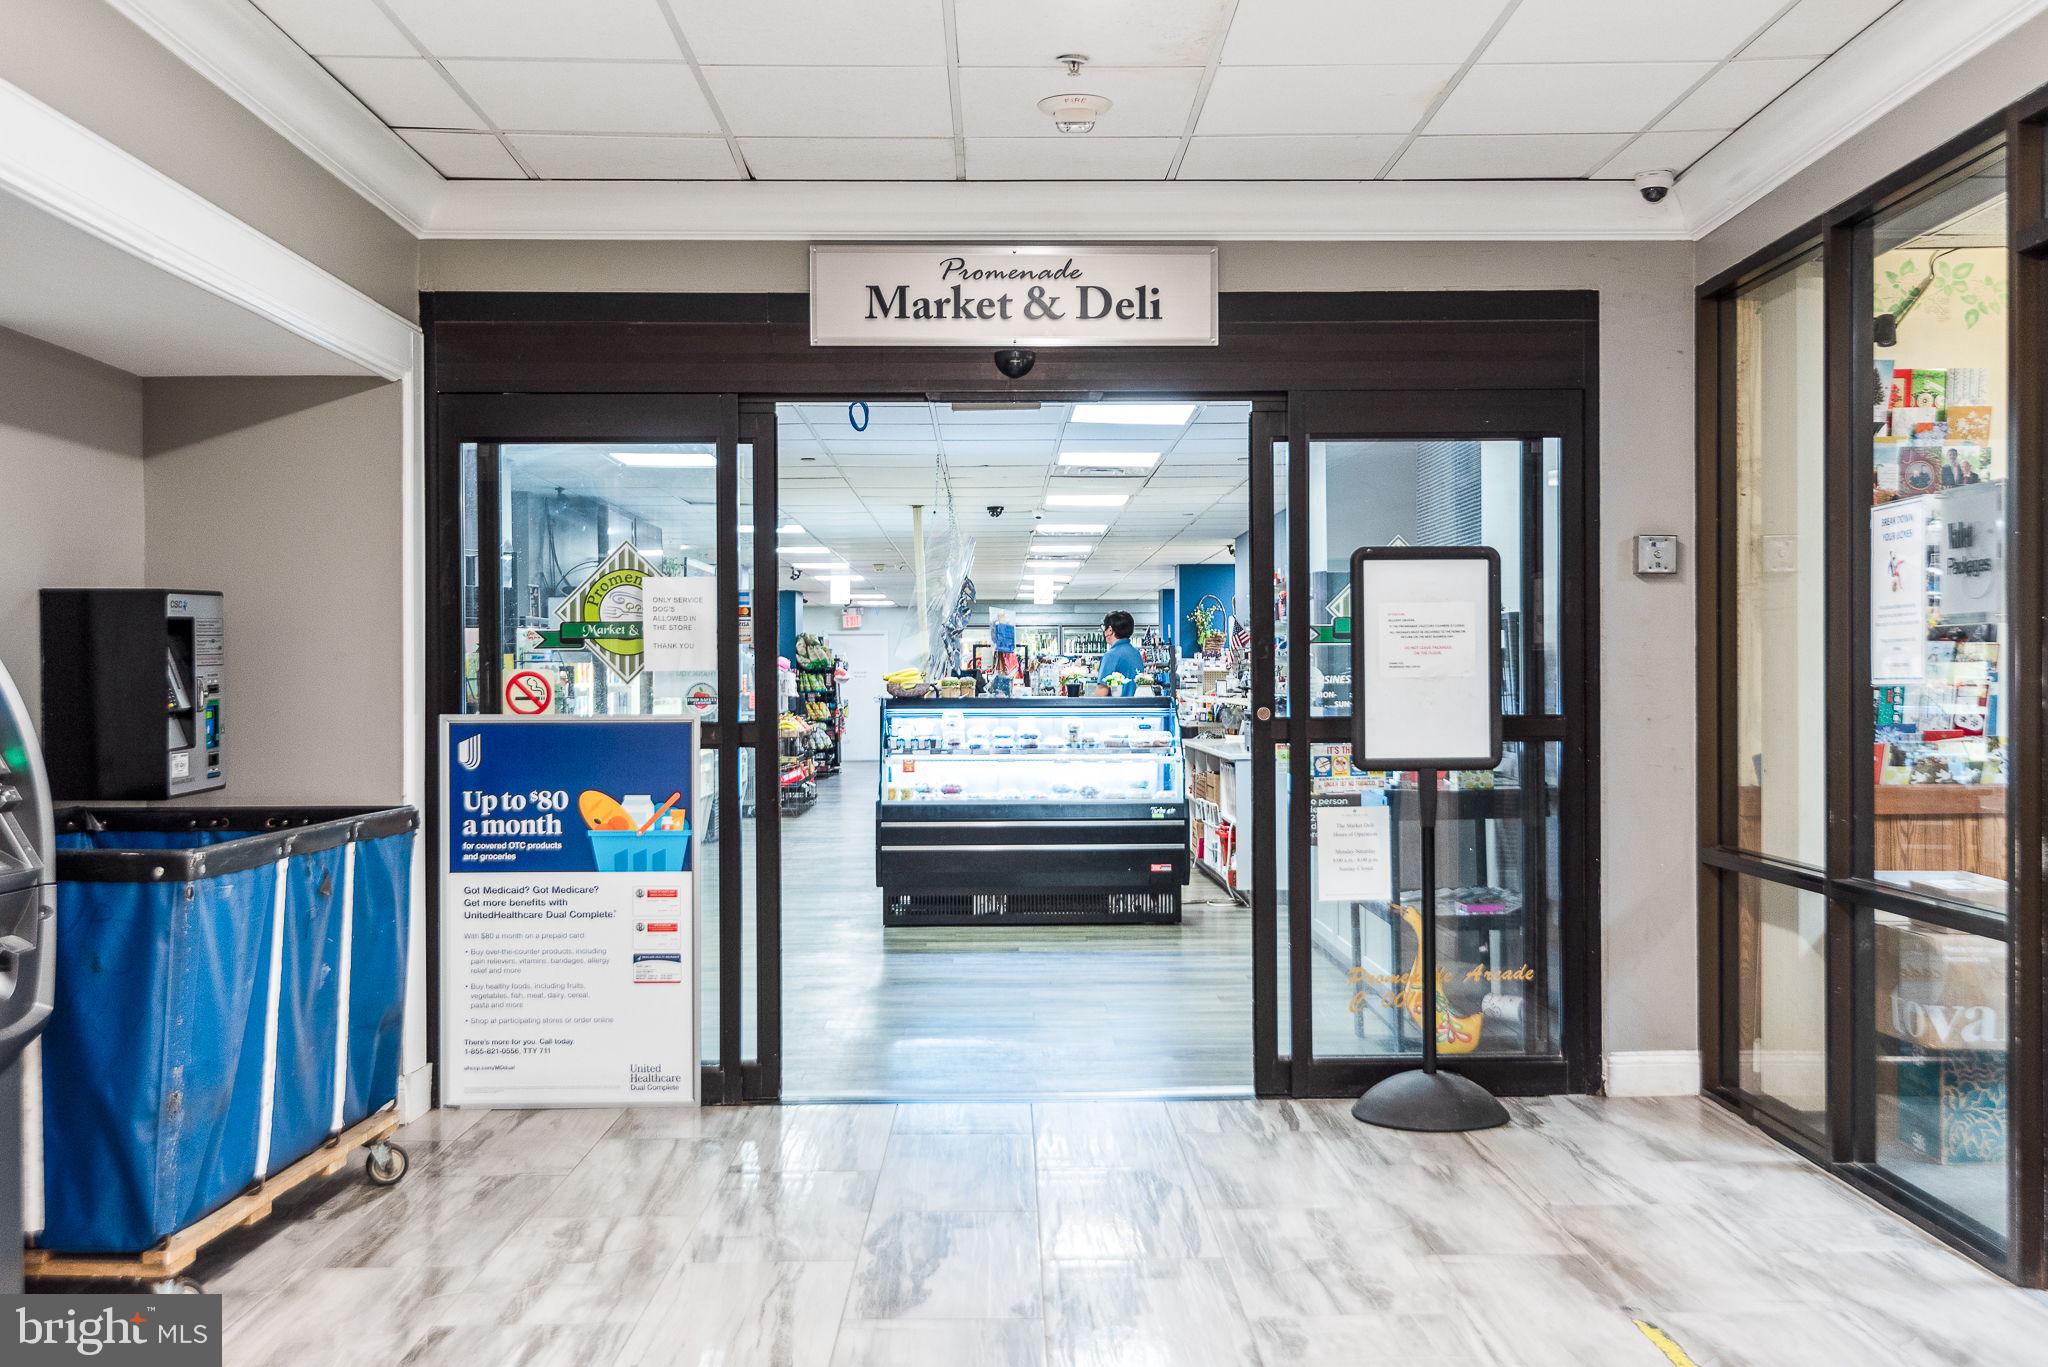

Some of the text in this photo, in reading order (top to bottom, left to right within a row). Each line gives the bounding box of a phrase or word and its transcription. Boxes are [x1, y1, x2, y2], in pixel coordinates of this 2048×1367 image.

[940, 257, 1084, 281] Promenade
[865, 284, 1163, 320] Market & Deli
[583, 624, 639, 636] Market &
[462, 790, 569, 816] Up to $80
[462, 814, 563, 836] a month
[462, 842, 562, 851] for covered OTC products
[462, 853, 516, 863] and groceries
[483, 886, 530, 894] Medicaid?
[464, 911, 543, 919] UnitedHealthcare
[546, 911, 566, 919] Dual
[481, 932, 494, 940] $80
[542, 932, 567, 941] prepaid
[471, 948, 484, 956] Buy
[575, 948, 607, 956] including
[1463, 963, 1536, 983] Arcade
[471, 983, 484, 991] Buy
[471, 1017, 488, 1025] Shop
[499, 1017, 540, 1026] participating
[631, 1064, 661, 1075] United
[631, 1074, 680, 1085] Healthcare
